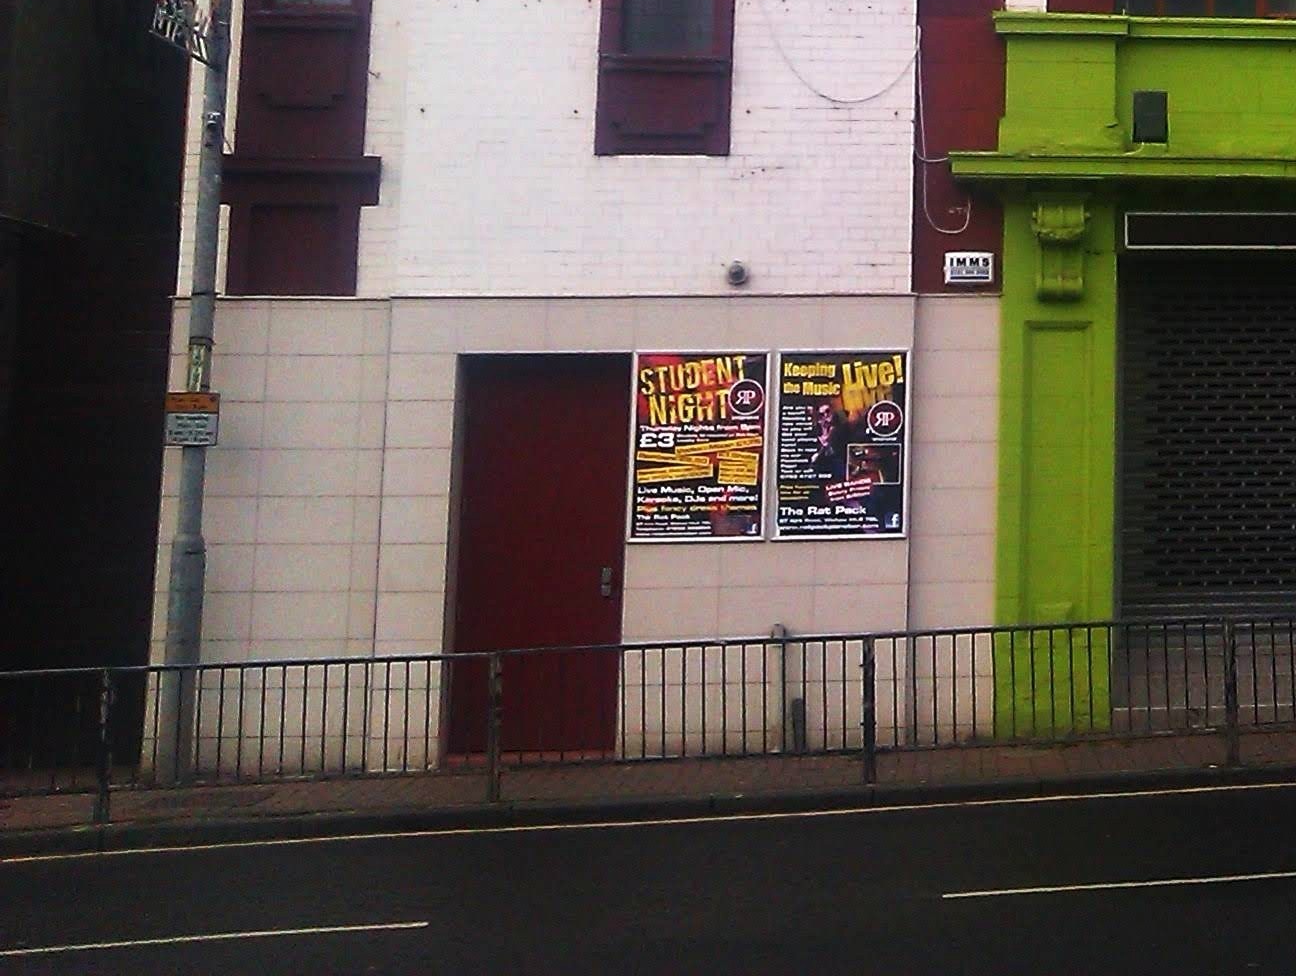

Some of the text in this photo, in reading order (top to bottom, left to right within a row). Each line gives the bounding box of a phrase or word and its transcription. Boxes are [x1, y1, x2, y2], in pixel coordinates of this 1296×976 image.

[640, 356, 746, 396] STUDENT
[784, 355, 904, 390] Keeping Live!
[783, 381, 841, 396] the Music
[684, 424, 715, 433] Nights
[640, 432, 675, 448] £3
[638, 486, 657, 494] Live
[661, 486, 695, 495] Music,
[698, 485, 724, 494] Open
[637, 495, 682, 504] Karaoke,
[729, 494, 759, 502] more!
[661, 505, 687, 513] fancy
[779, 505, 867, 516] The Rat Pack
